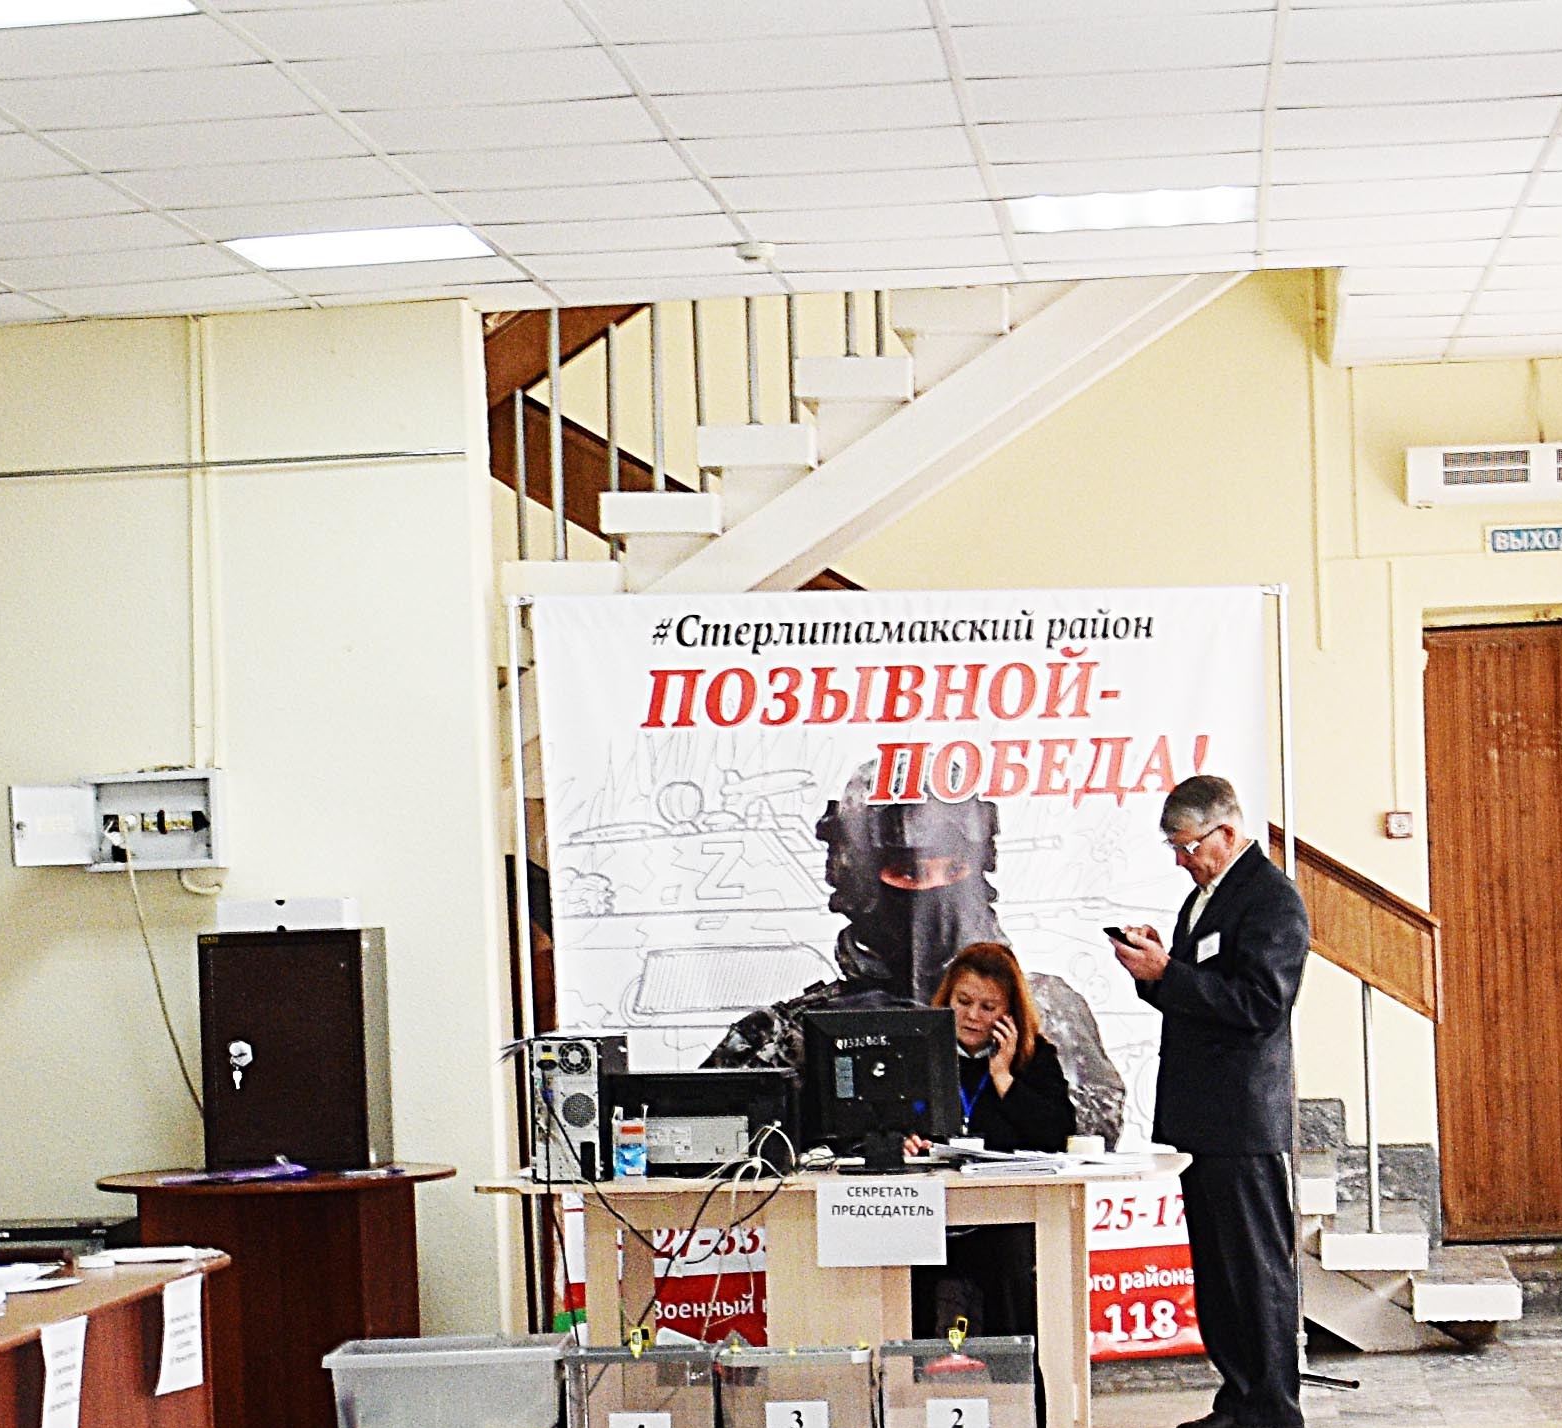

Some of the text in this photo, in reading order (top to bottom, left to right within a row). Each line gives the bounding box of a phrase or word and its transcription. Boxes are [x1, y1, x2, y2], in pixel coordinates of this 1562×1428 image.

[652, 608, 1154, 655] #Стерлитамакский район
[640, 646, 1121, 728] ПОЗЫВНОЙ-
[869, 734, 1210, 809] ПОБЕДА!
[831, 1204, 934, 1218] ПРЕДСЕДАТЕЛЬ
[846, 1186, 919, 1198] СЕКРЕТАТЬ
[1104, 1299, 1179, 1342] 118
